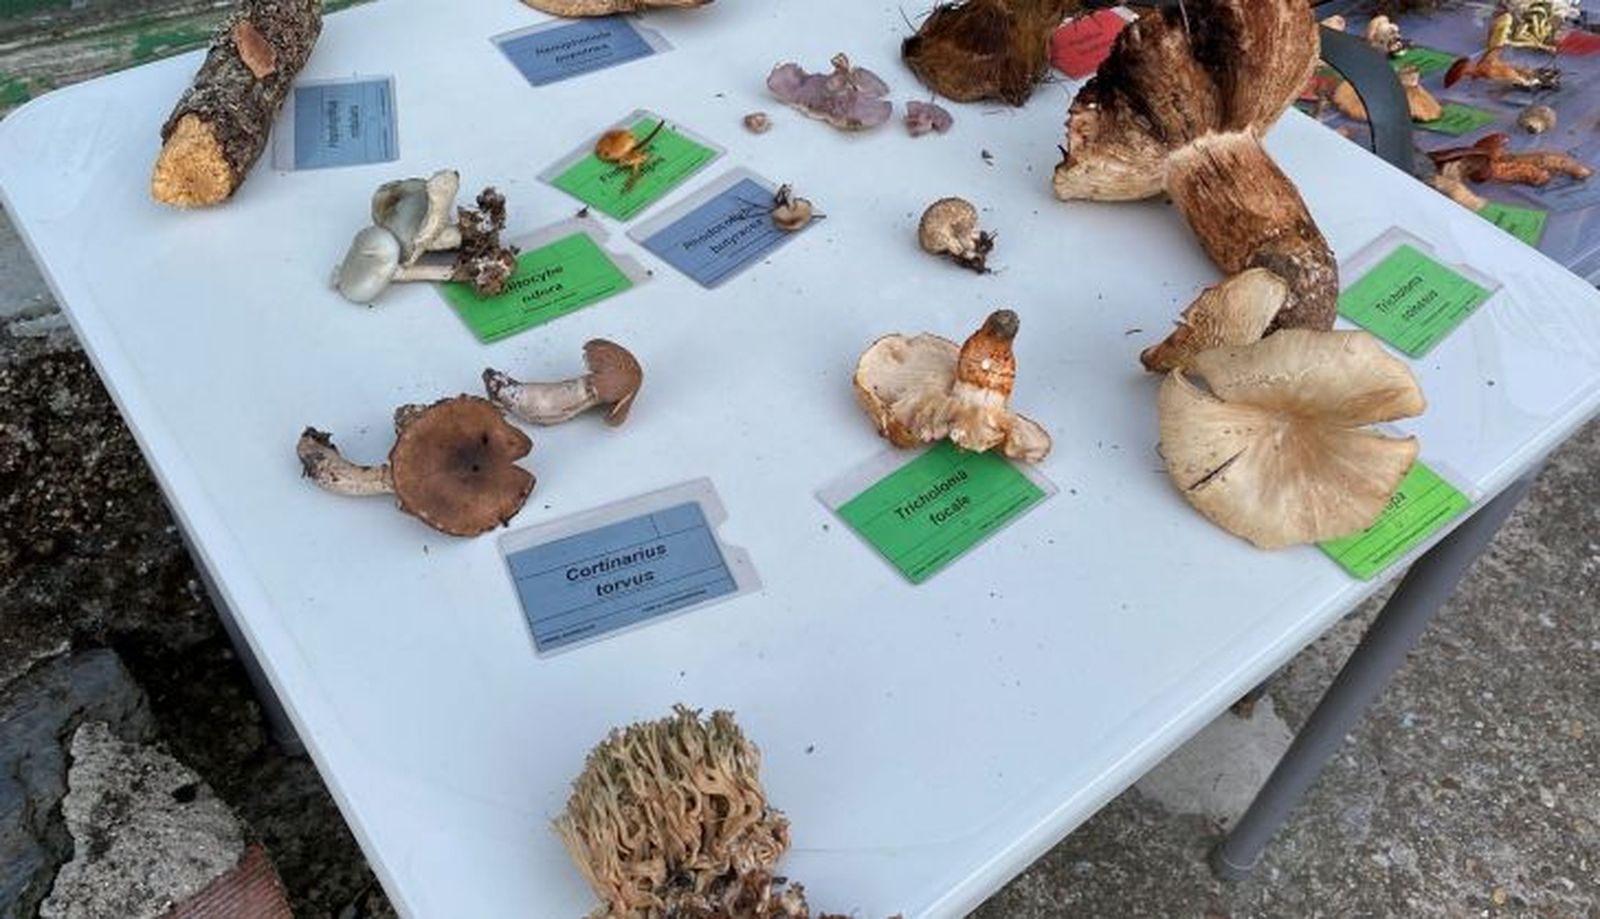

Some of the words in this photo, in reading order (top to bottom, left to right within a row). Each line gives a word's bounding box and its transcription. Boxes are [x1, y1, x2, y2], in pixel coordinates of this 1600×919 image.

[499, 264, 565, 295] litocybe
[1375, 273, 1425, 315] Tricholoma
[893, 469, 969, 520] Tricholoma
[928, 494, 972, 527] focale
[565, 541, 668, 582] Cortinarius
[595, 568, 655, 597] torvus
